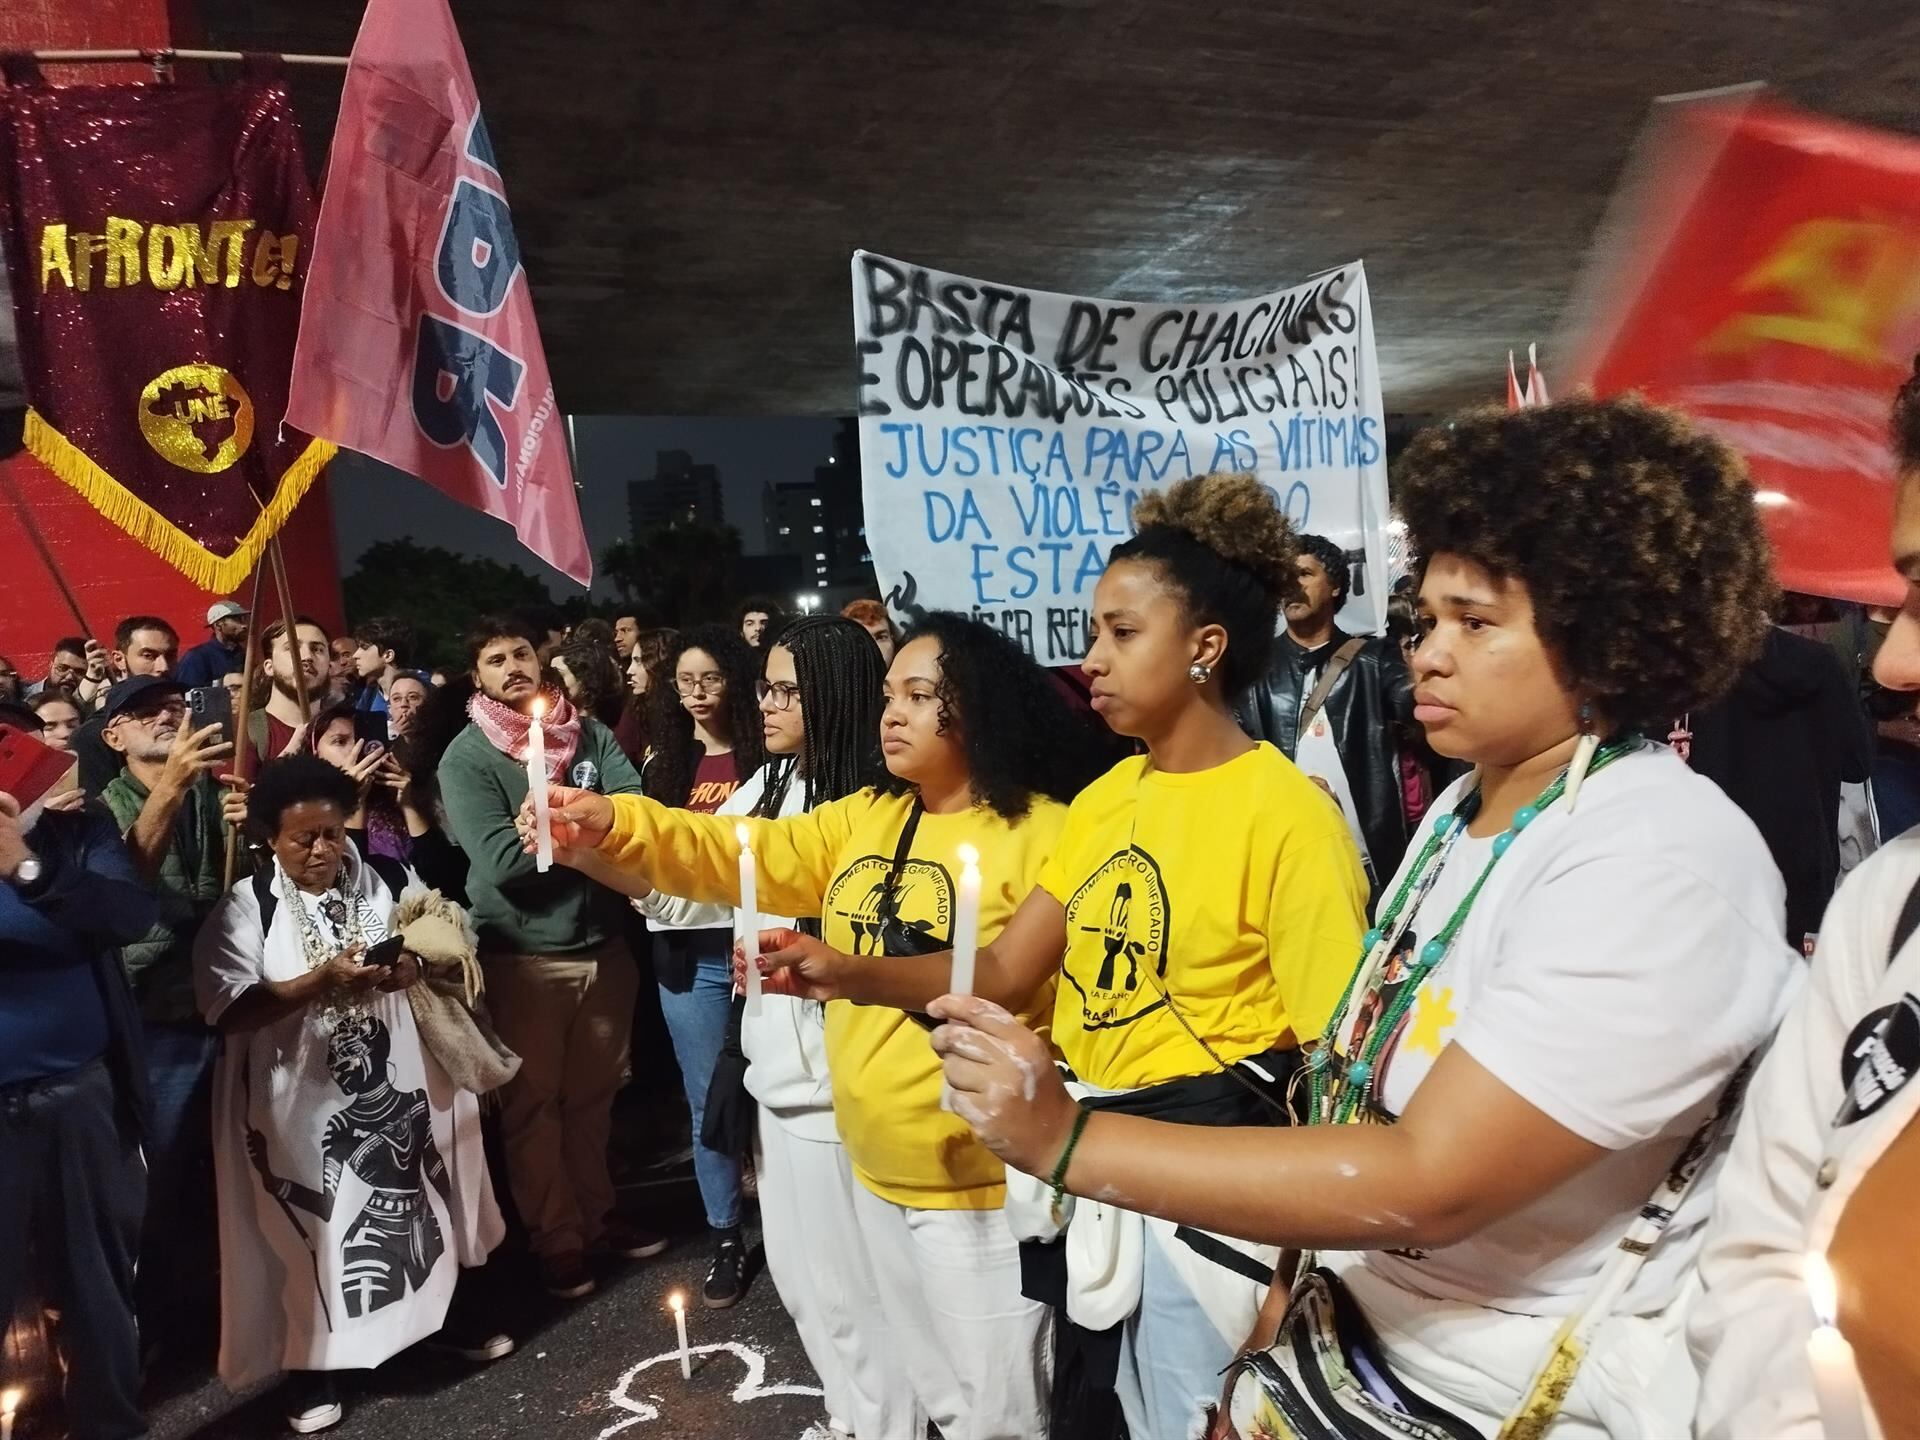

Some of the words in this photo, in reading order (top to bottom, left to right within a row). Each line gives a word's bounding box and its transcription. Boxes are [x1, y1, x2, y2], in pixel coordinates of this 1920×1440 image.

[862, 256, 1035, 354] BASTA
[1054, 301, 1136, 373] DE
[1140, 272, 1356, 373] CHACINAS
[175, 395, 230, 424] UNE
[857, 340, 892, 416] E
[880, 423, 1073, 483] JUSTIÇA
[1084, 427, 1193, 483] PARA
[1209, 429, 1258, 474] AS
[1269, 411, 1379, 472] VÍTIMAS
[924, 488, 992, 543] DA
[829, 861, 889, 907] MOVIMENTO
[929, 868, 949, 925] NIFICADO
